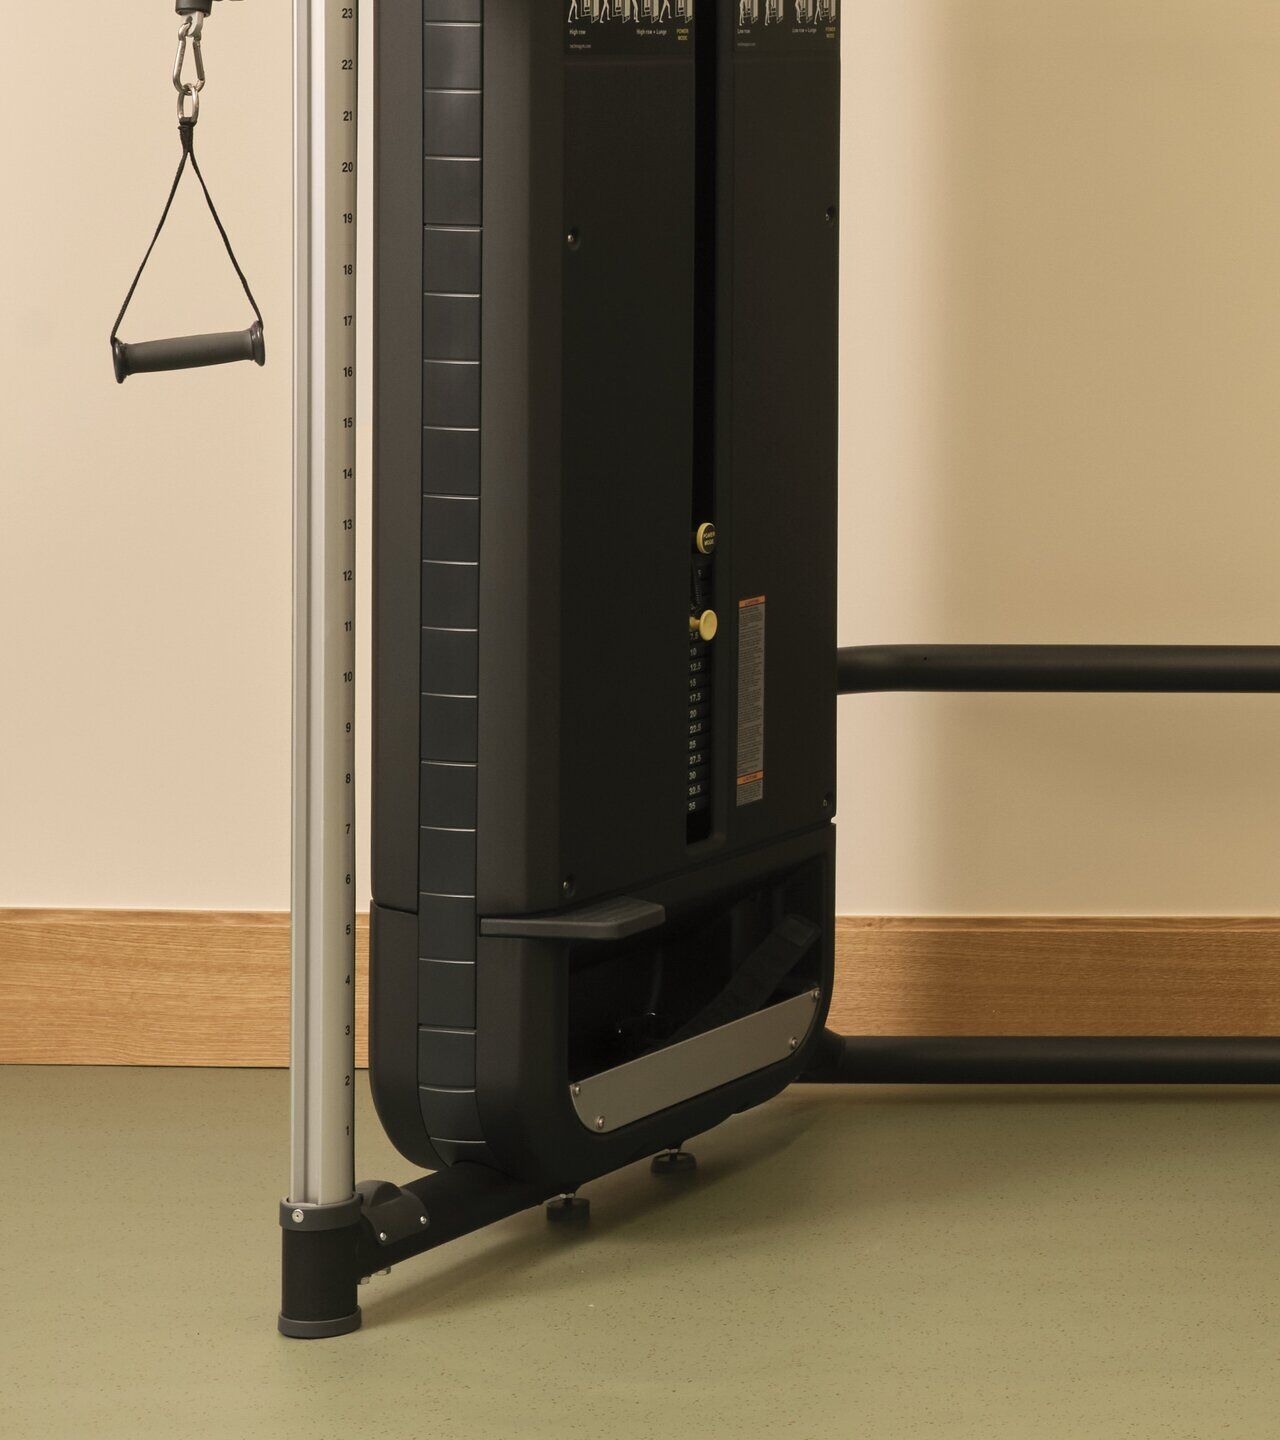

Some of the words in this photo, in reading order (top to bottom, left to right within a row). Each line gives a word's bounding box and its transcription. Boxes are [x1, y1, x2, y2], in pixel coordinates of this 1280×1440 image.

[341, 7, 353, 19] 23
[341, 58, 353, 71] 22
[342, 110, 353, 122] 21
[341, 161, 354, 173] 20
[343, 212, 353, 224] 19
[342, 264, 353, 276] 18
[343, 314, 353, 327] 17
[343, 366, 353, 378] 16
[343, 416, 353, 429] 15
[342, 467, 353, 480] 14
[342, 518, 353, 531] 13
[342, 569, 353, 582] 12
[344, 620, 352, 632] 11
[343, 671, 353, 683] 10
[345, 721, 352, 733] 9
[345, 772, 352, 784] 8
[346, 823, 351, 835] 7
[345, 873, 351, 885] 6
[345, 923, 351, 936] 5
[345, 974, 351, 985] 4
[345, 1024, 351, 1036] 3
[344, 1075, 351, 1087] 2
[346, 1125, 350, 1136] 1
